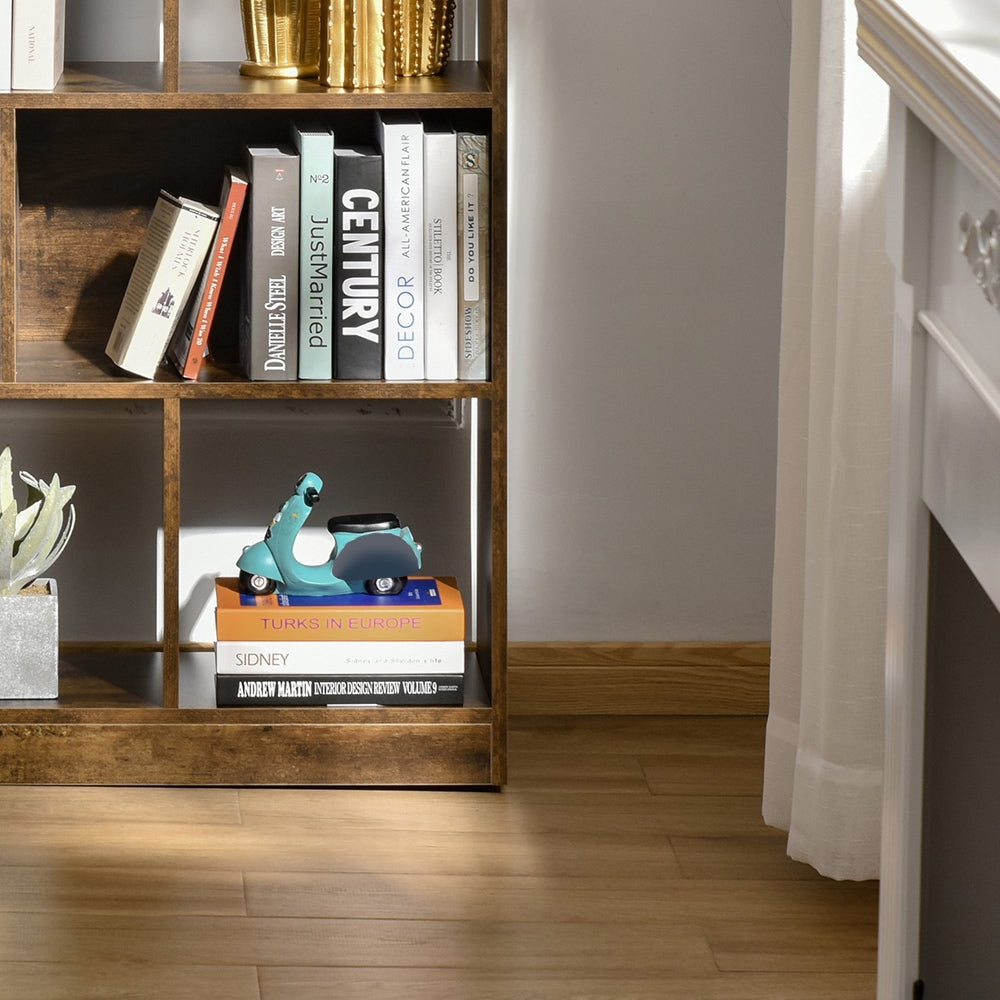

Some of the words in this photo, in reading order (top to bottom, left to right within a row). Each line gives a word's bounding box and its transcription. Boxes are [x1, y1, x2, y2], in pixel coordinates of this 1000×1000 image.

[28, 25, 36, 64] NATIONAL
[400, 134, 410, 166] FLAIR
[271, 206, 286, 223] ART
[400, 168, 410, 258] ALL-AMERICAN
[468, 202, 475, 212] IT
[270, 226, 286, 256] DESIGN
[434, 218, 442, 264] STILETTO
[342, 188, 380, 344] CENTURY
[434, 268, 442, 295] BOOK
[468, 268, 475, 282] DO
[264, 274, 286, 311] STEEL
[396, 276, 414, 360] DECOR
[264, 313, 286, 371] DANIELLE
[260, 618, 320, 630] TURKS
[325, 618, 342, 629] IN
[348, 617, 424, 630] EUROPE
[236, 653, 290, 666] SIDNEY
[237, 681, 276, 698] ANDREW
[278, 680, 312, 698] MARTIN
[314, 682, 346, 695] INTERIOR
[347, 682, 374, 695] DESIGN
[374, 681, 400, 695] REVIEW
[402, 681, 432, 694] VOLUME
[432, 682, 438, 694] 9
